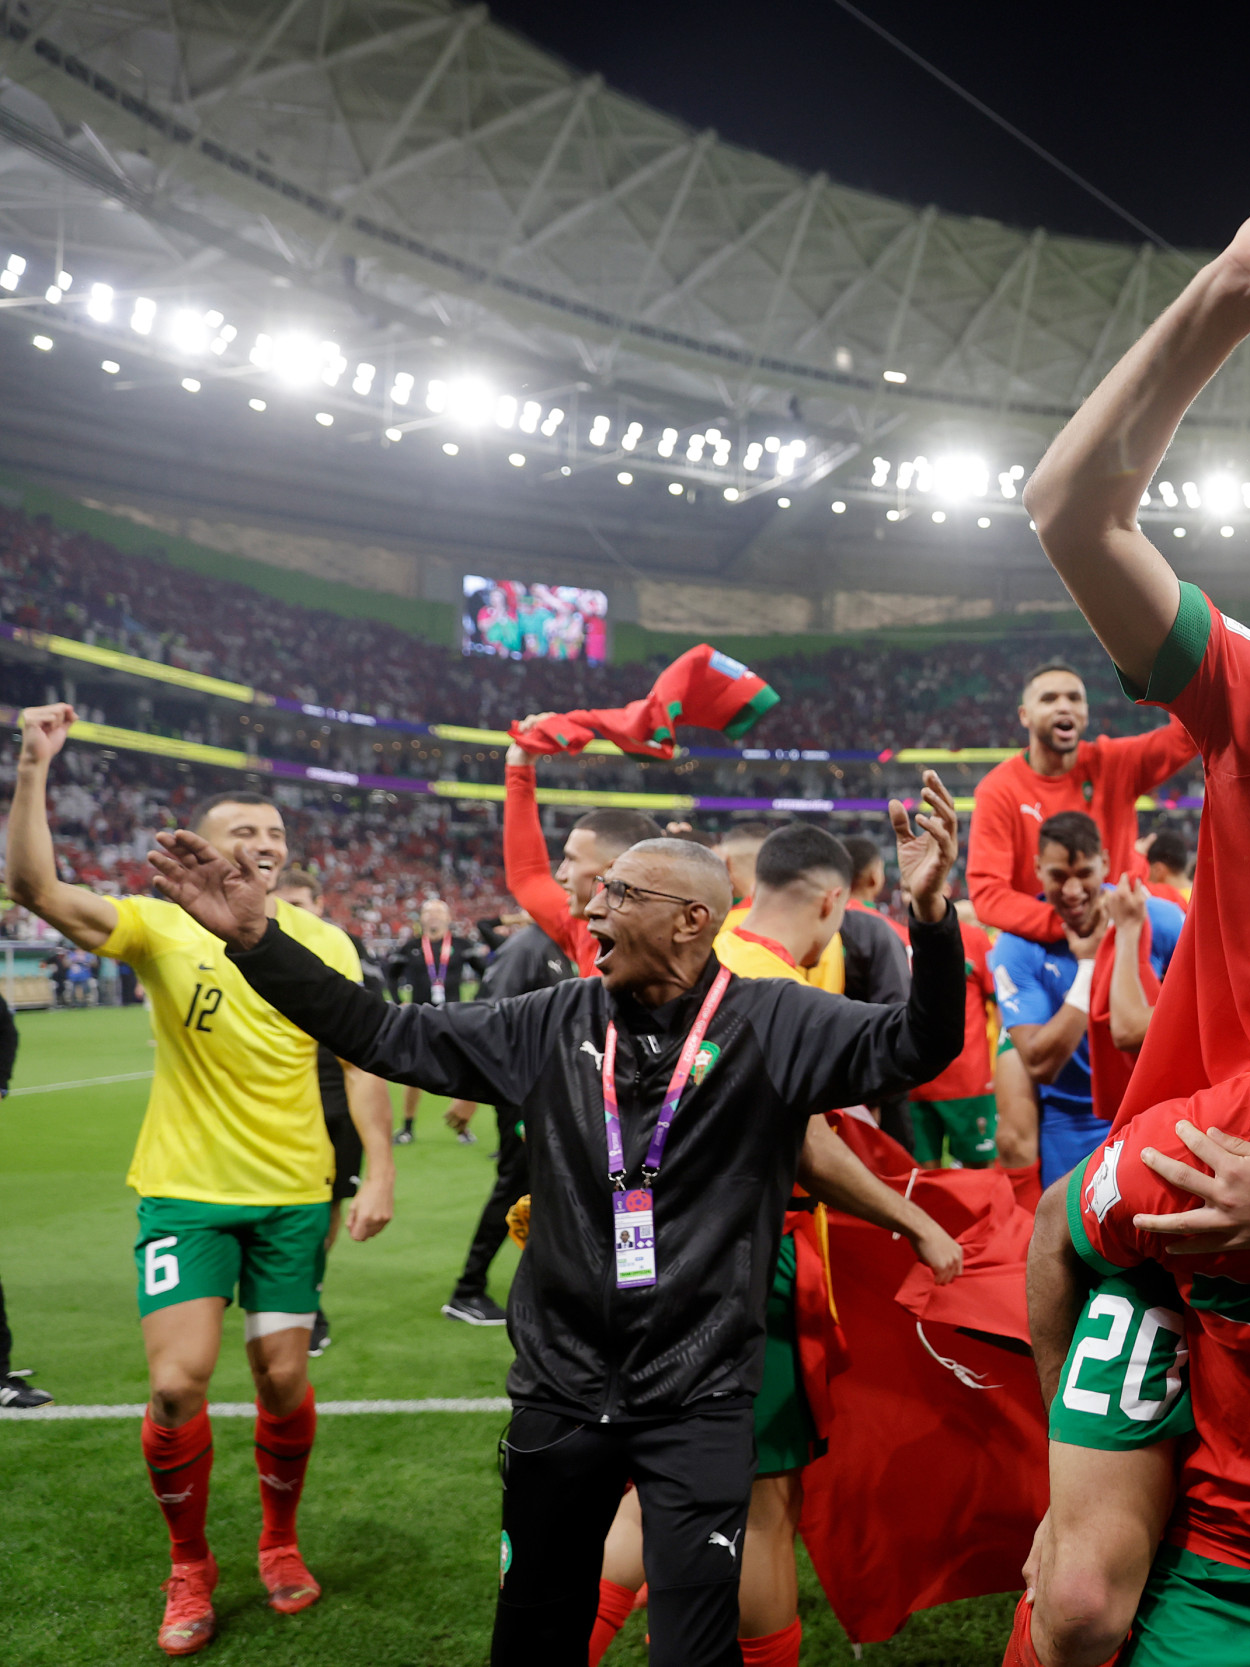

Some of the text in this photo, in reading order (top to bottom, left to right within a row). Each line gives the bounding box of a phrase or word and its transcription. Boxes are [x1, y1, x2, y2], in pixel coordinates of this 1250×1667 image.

[184, 983, 222, 1032] 12
[145, 1235, 180, 1296] 6
[1062, 1293, 1189, 1421] 20
